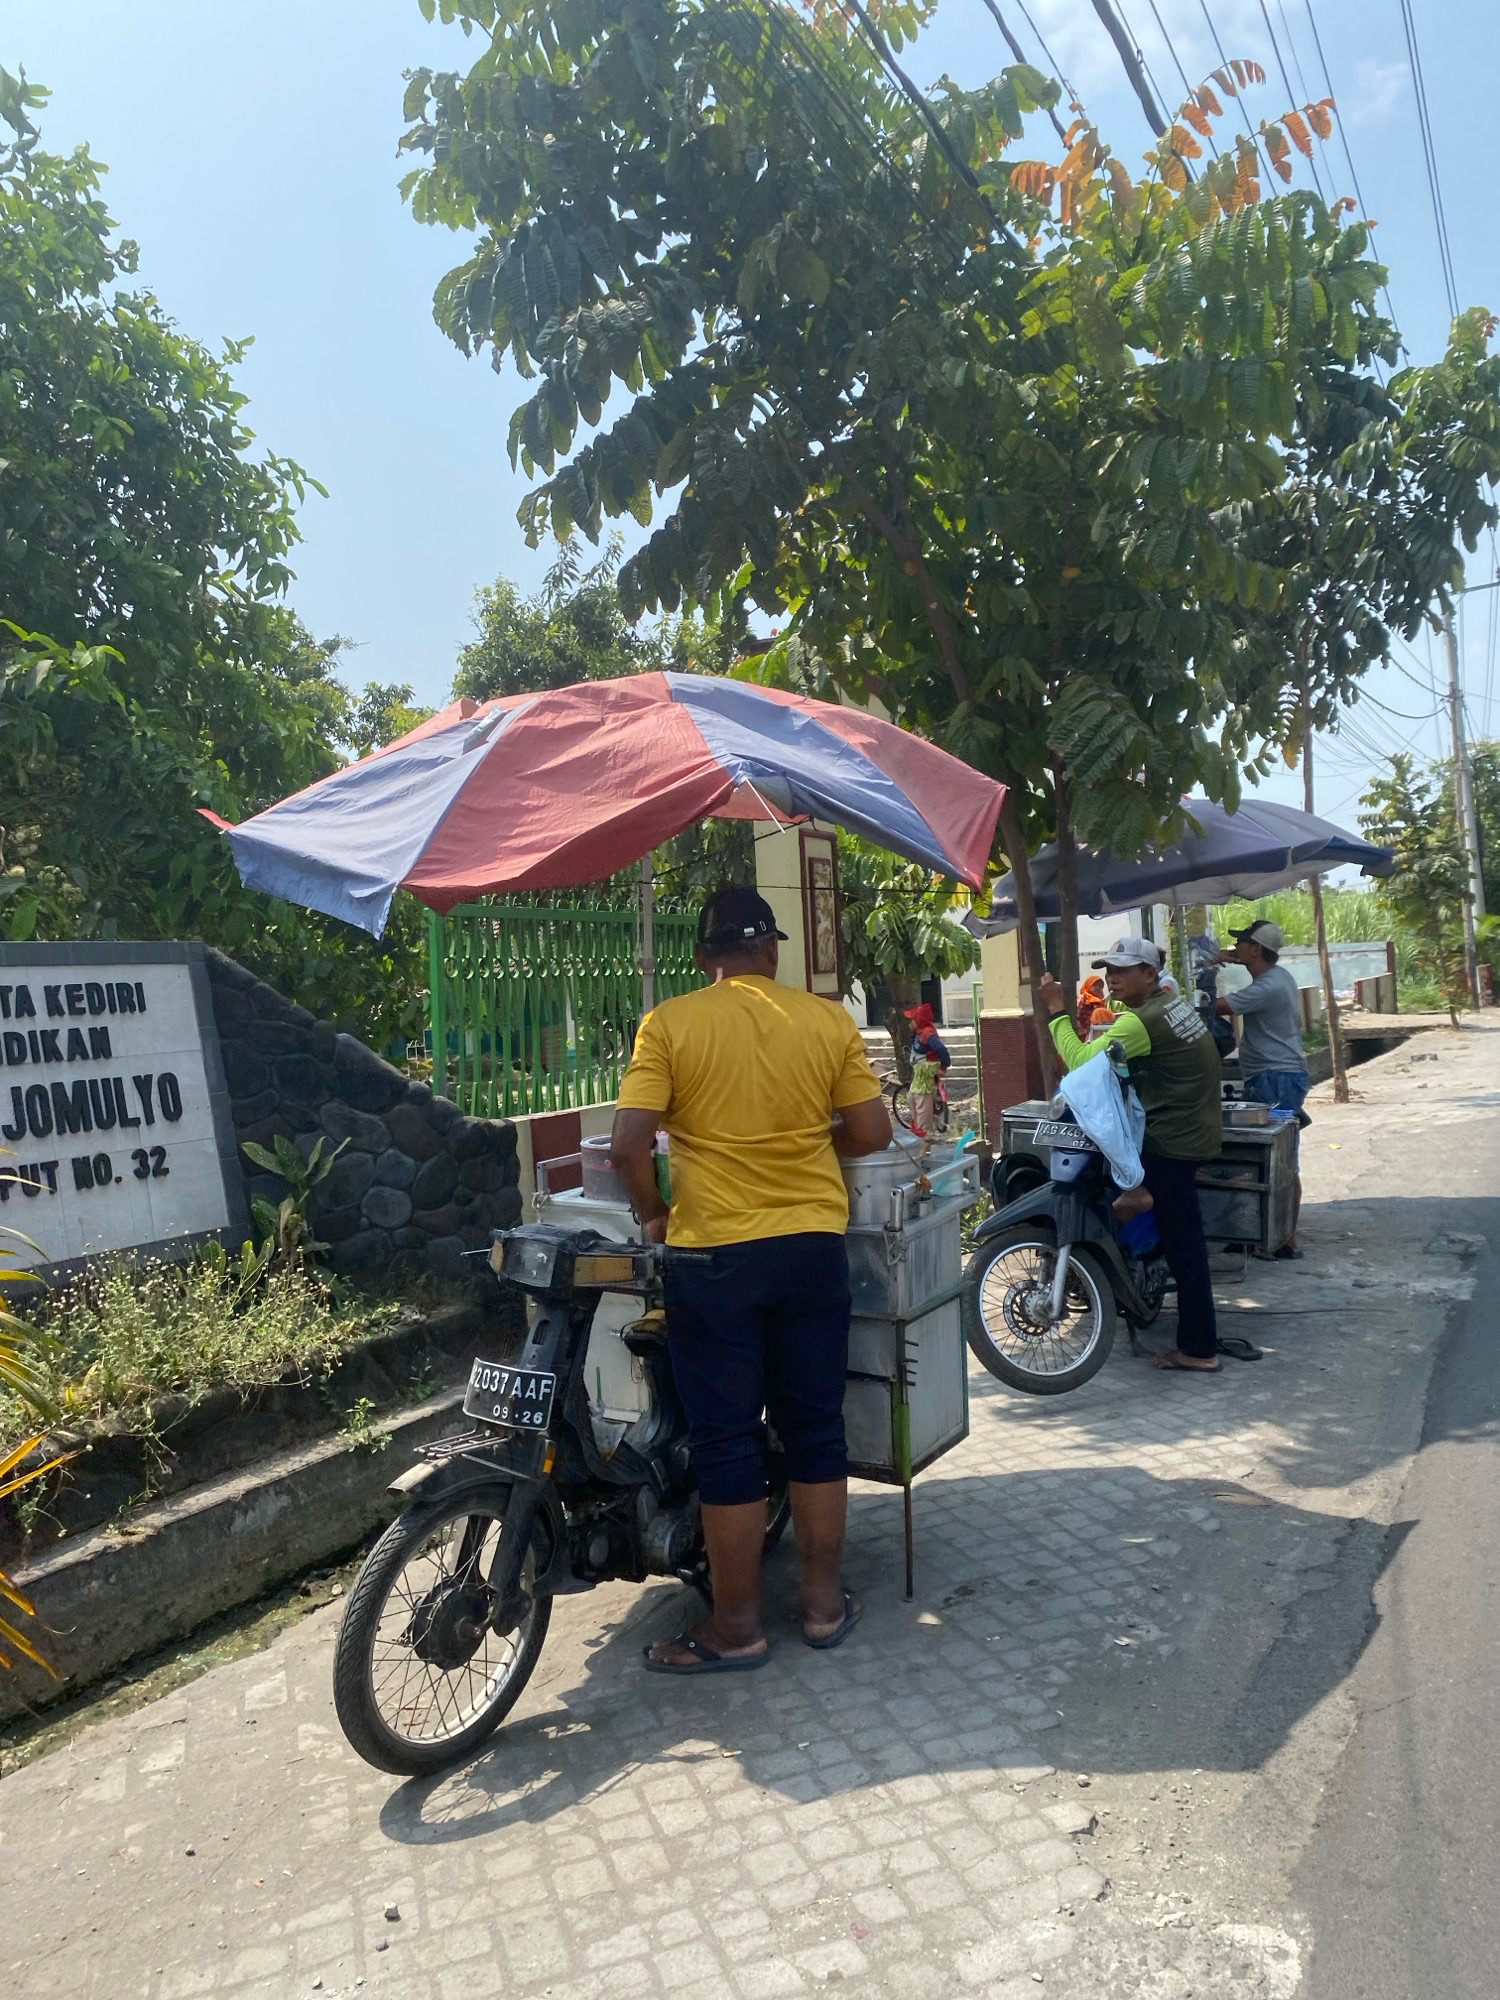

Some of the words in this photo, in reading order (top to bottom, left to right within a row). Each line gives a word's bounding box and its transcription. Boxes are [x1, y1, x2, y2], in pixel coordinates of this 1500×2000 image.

[44, 982, 147, 1017] KEDIRI
[0, 1026, 113, 1066] DIKAN
[2, 1072, 184, 1142] JOMULYO
[71, 1152, 123, 1192] NO.
[131, 1145, 170, 1180] 32
[473, 1366, 509, 1395] 2037
[511, 1376, 552, 1401] AAF
